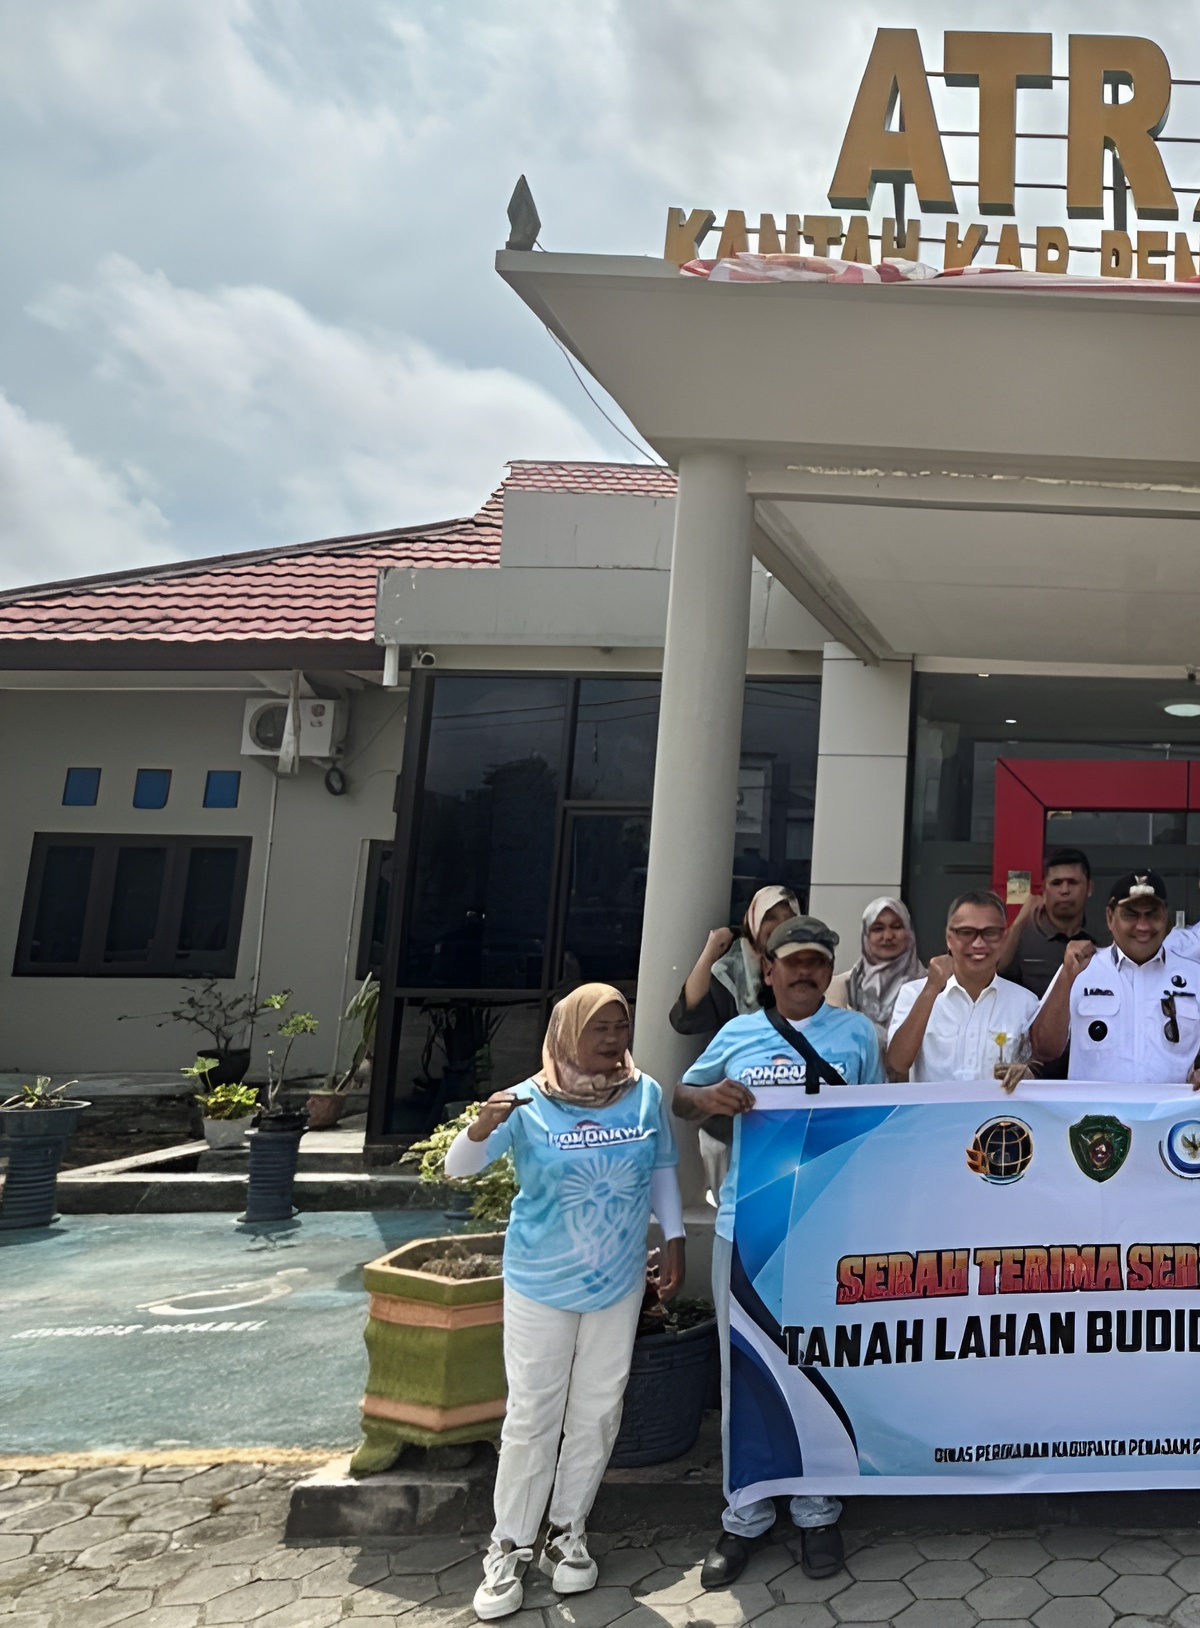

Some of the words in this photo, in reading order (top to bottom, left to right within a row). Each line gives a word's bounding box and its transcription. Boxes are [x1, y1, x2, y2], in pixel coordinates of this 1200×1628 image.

[664, 207, 920, 268] KANTAH
[836, 1248, 971, 1305] SERAH
[973, 1244, 1124, 1295] TERIMA
[781, 1316, 924, 1367] TANAH
[934, 1311, 1076, 1361] LAHAN
